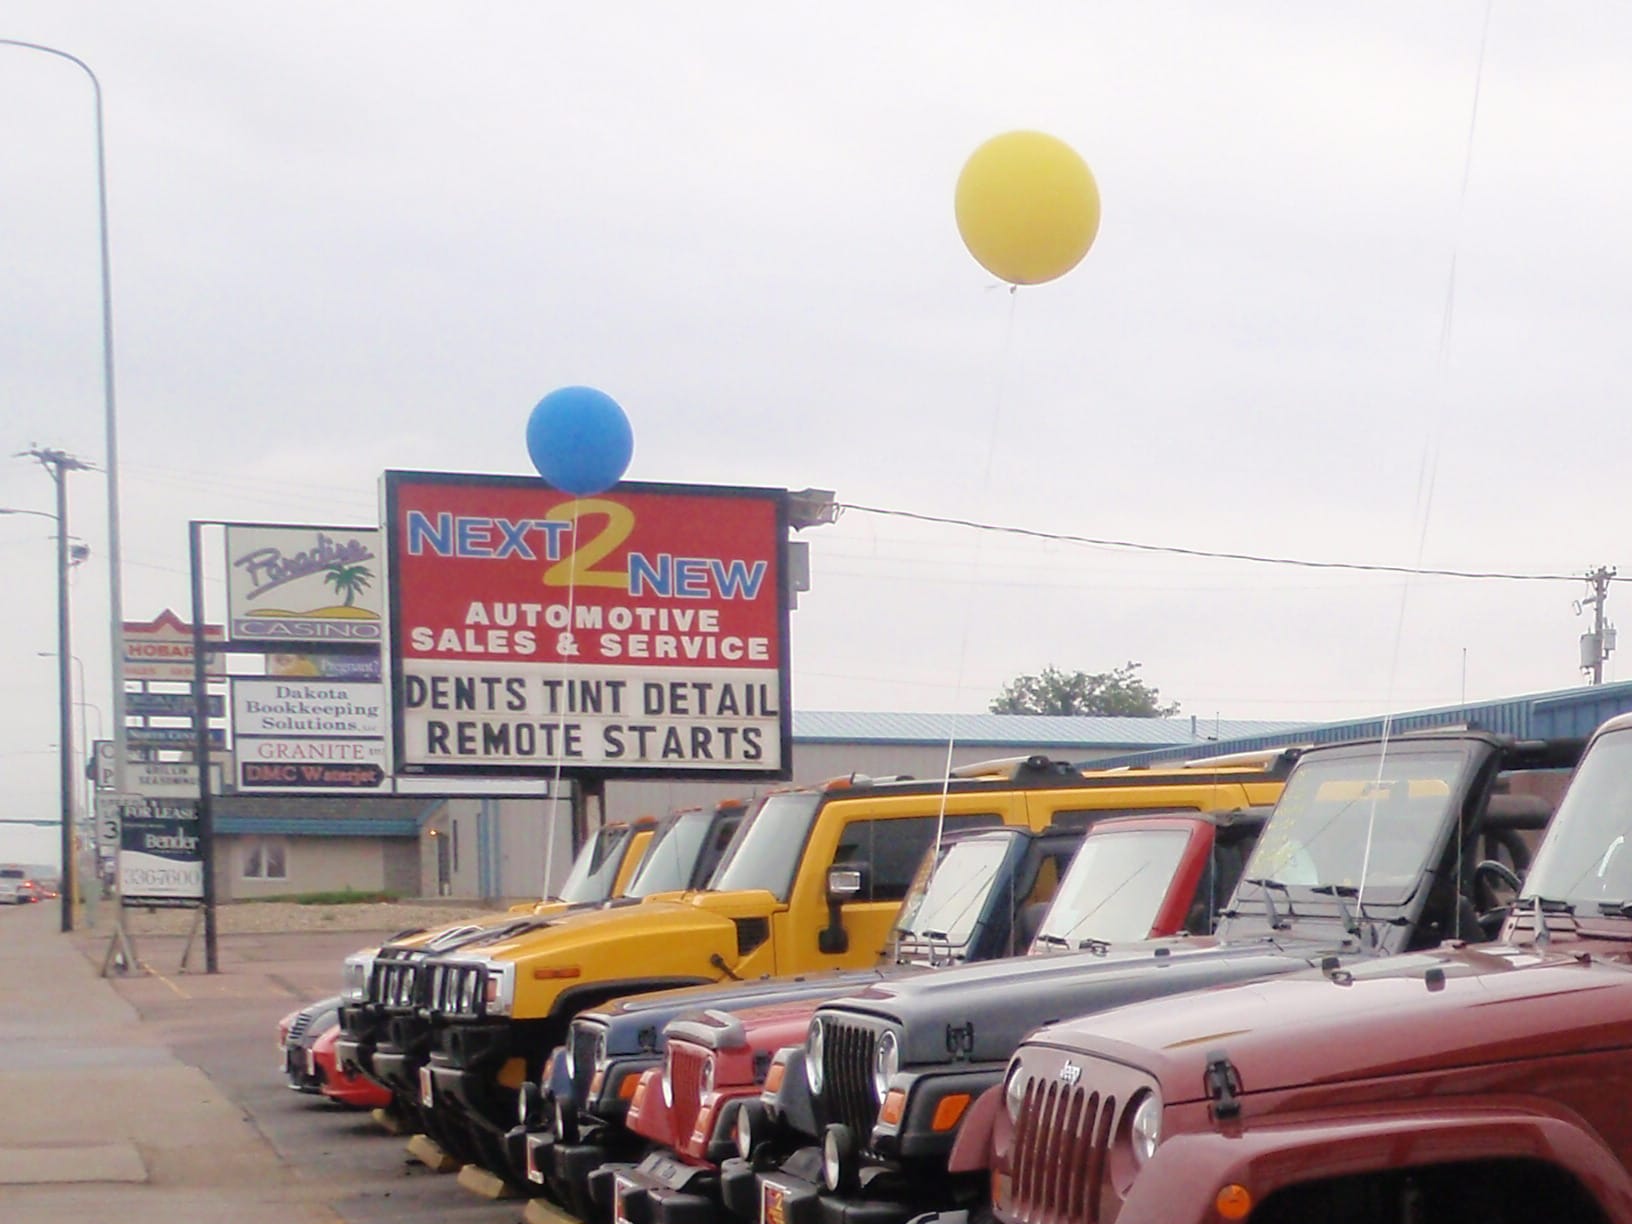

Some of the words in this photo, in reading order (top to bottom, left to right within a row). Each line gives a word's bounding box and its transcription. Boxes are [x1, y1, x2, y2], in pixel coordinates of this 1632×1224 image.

[407, 510, 574, 561] NEXT
[542, 498, 636, 588] 2
[627, 553, 768, 600] NEW
[465, 602, 720, 632] AUTOMOTIVE
[240, 622, 380, 637] CASINO
[128, 644, 200, 657] HOBAR
[411, 627, 537, 655] SALES
[556, 632, 579, 656] &
[600, 633, 769, 660] SERVICE
[276, 686, 349, 700] Dakota
[406, 675, 526, 711] DENTS
[543, 680, 626, 714] TINT
[644, 682, 778, 717] DETAIL
[245, 700, 379, 718] Bookkeeping
[428, 720, 583, 757] REMOTE
[604, 725, 763, 760] STARTS
[258, 743, 365, 760] GRANITE
[246, 765, 298, 781] DMC
[124, 805, 152, 819] FOR
[155, 805, 200, 820] LEASE
